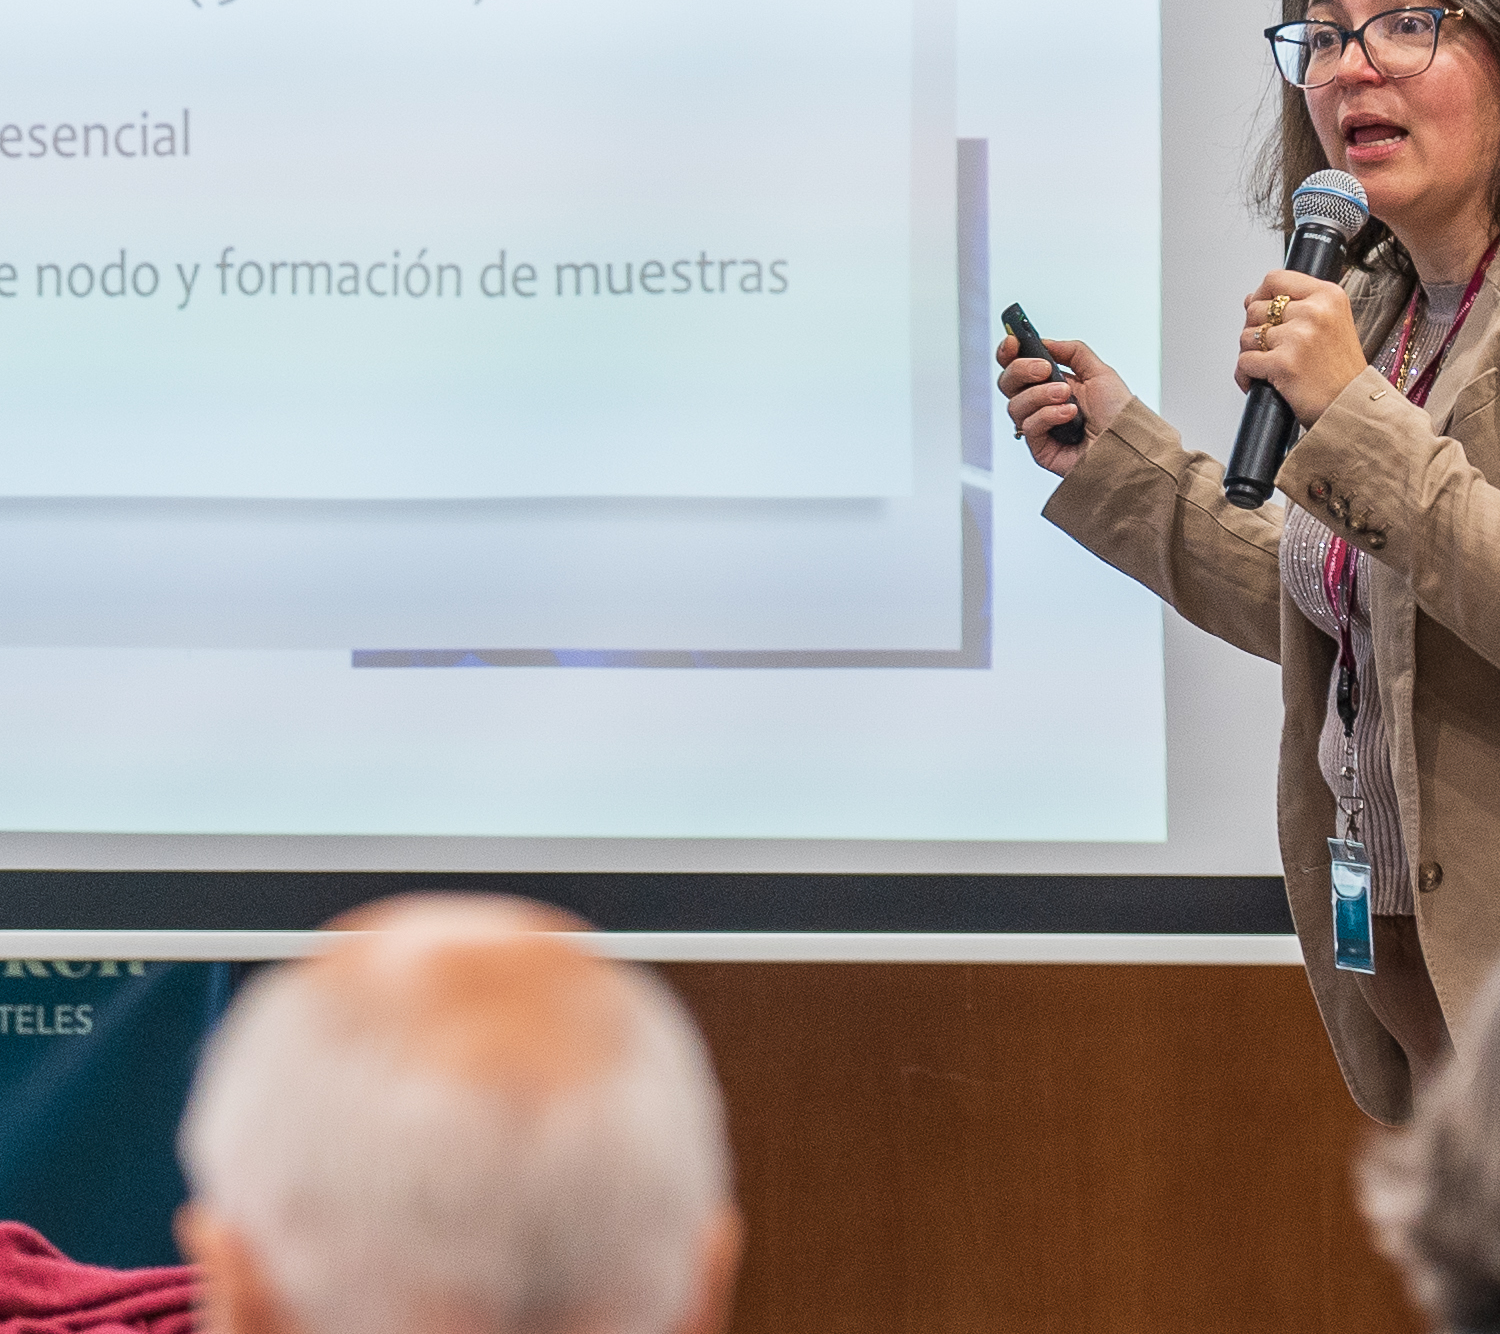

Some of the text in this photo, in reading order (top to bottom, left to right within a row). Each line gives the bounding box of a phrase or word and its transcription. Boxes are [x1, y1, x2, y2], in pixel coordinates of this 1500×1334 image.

[35, 247, 161, 299] nodo
[174, 262, 201, 311] y
[214, 245, 463, 299] formación
[478, 248, 538, 300] de
[554, 250, 788, 298] muestras
